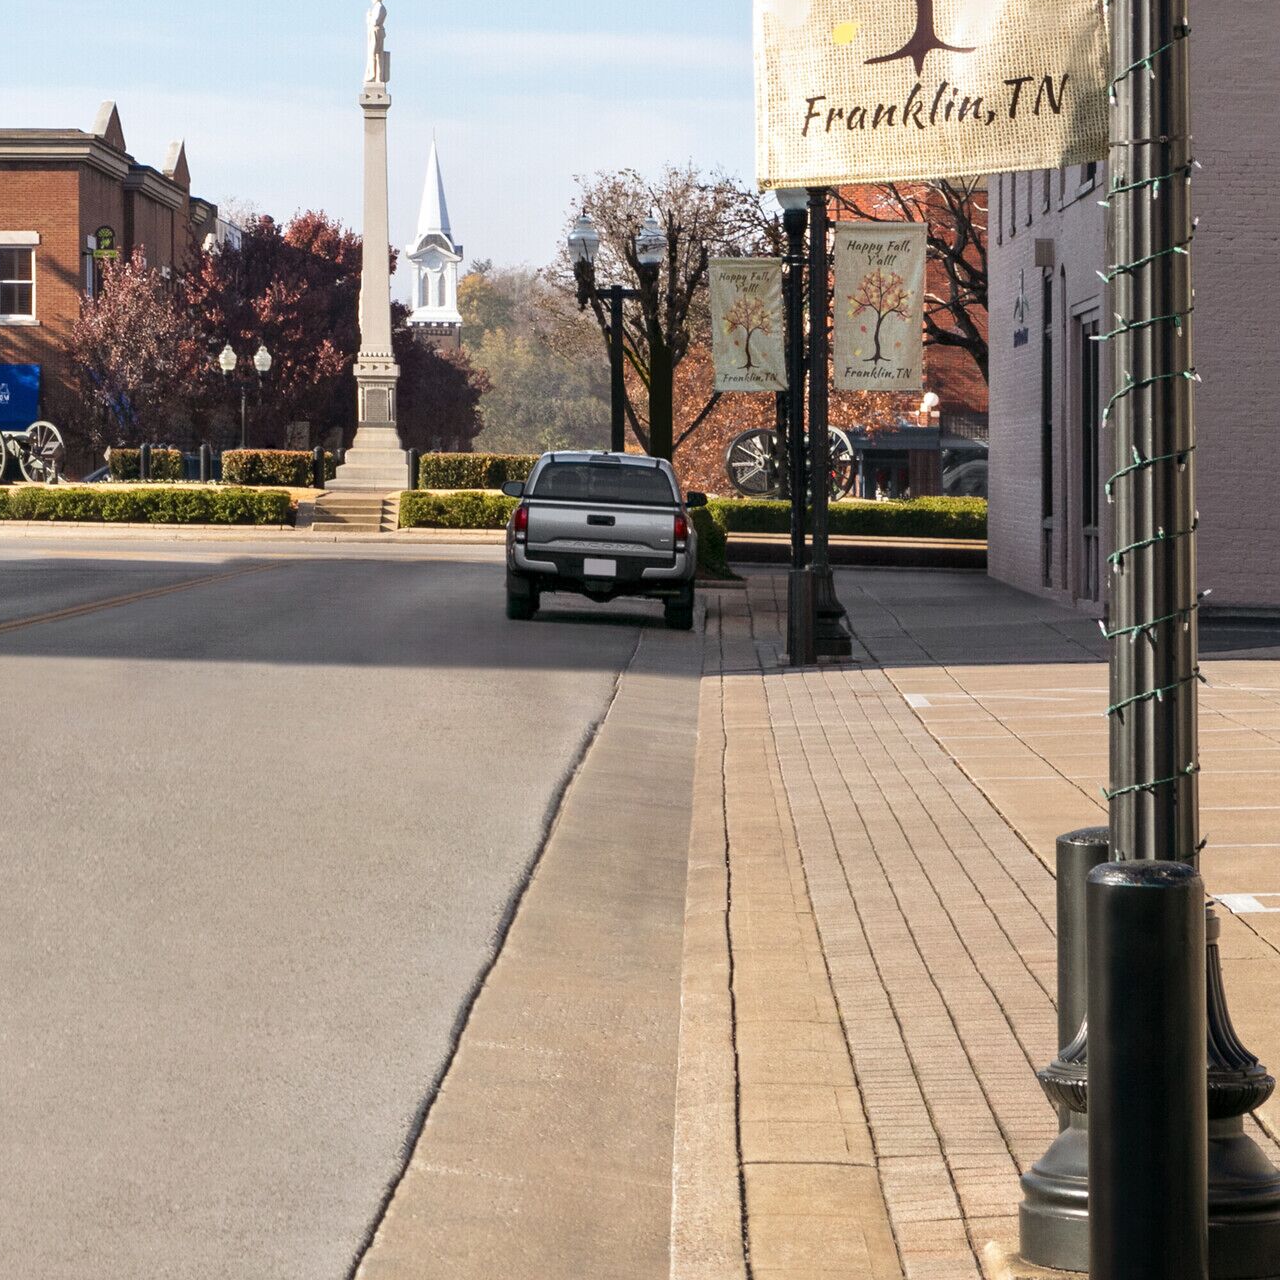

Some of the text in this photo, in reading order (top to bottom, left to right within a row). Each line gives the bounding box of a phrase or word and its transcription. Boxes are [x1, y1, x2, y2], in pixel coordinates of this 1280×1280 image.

[846, 239, 911, 255] Happy Fall,
[867, 254, 897, 266] Y'all!
